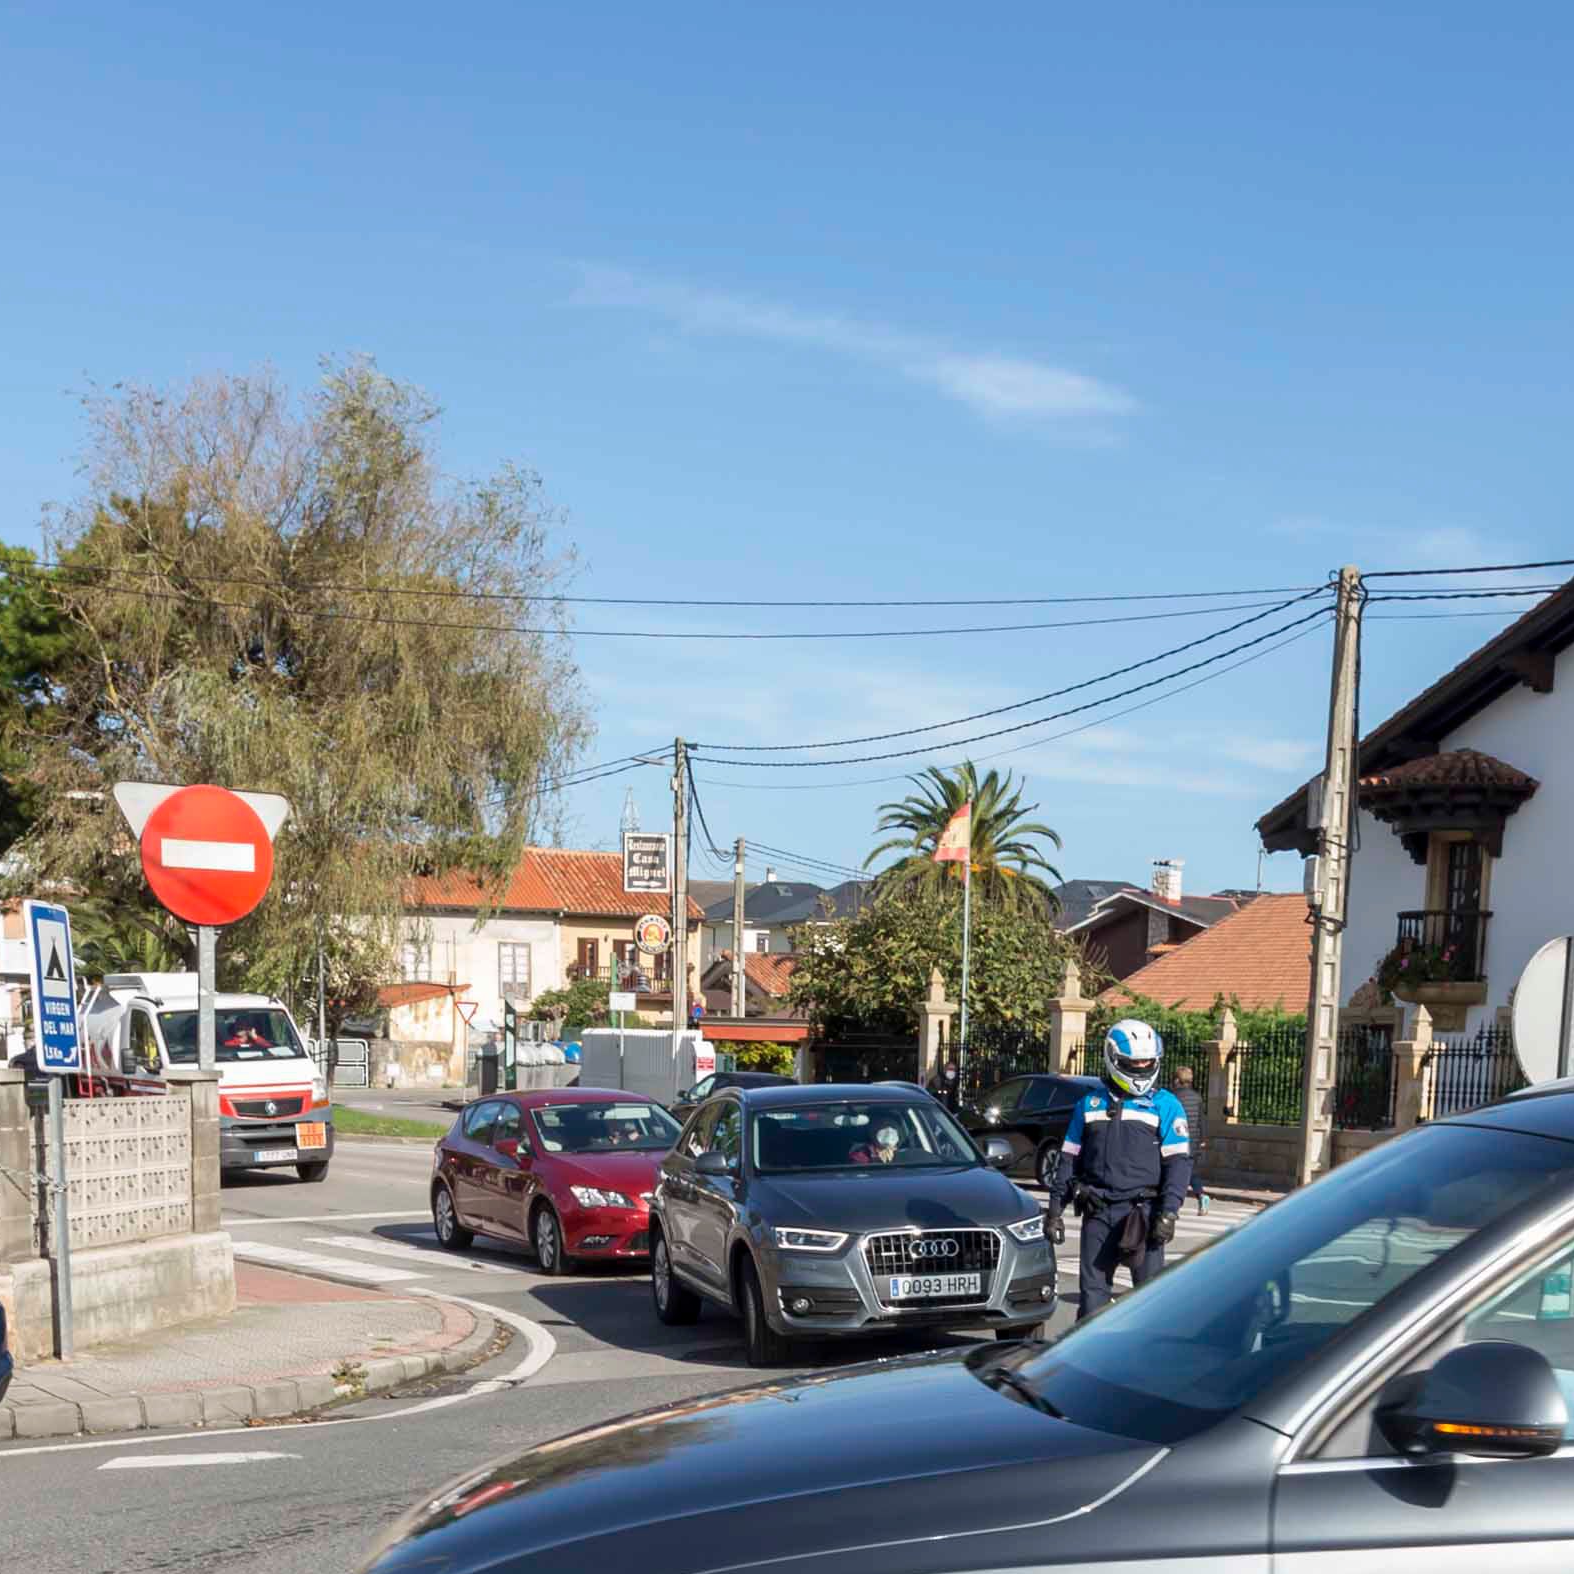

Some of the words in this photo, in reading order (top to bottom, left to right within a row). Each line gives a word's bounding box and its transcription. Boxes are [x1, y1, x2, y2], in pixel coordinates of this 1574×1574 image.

[632, 852, 660, 864] Casa
[628, 866, 666, 880] Miguel
[44, 1001, 71, 1016] VIRGEN
[43, 1021, 57, 1035] DEL
[59, 1022, 75, 1035] MAR
[902, 1278, 942, 1295] 0093
[947, 1276, 978, 1293] HRH
